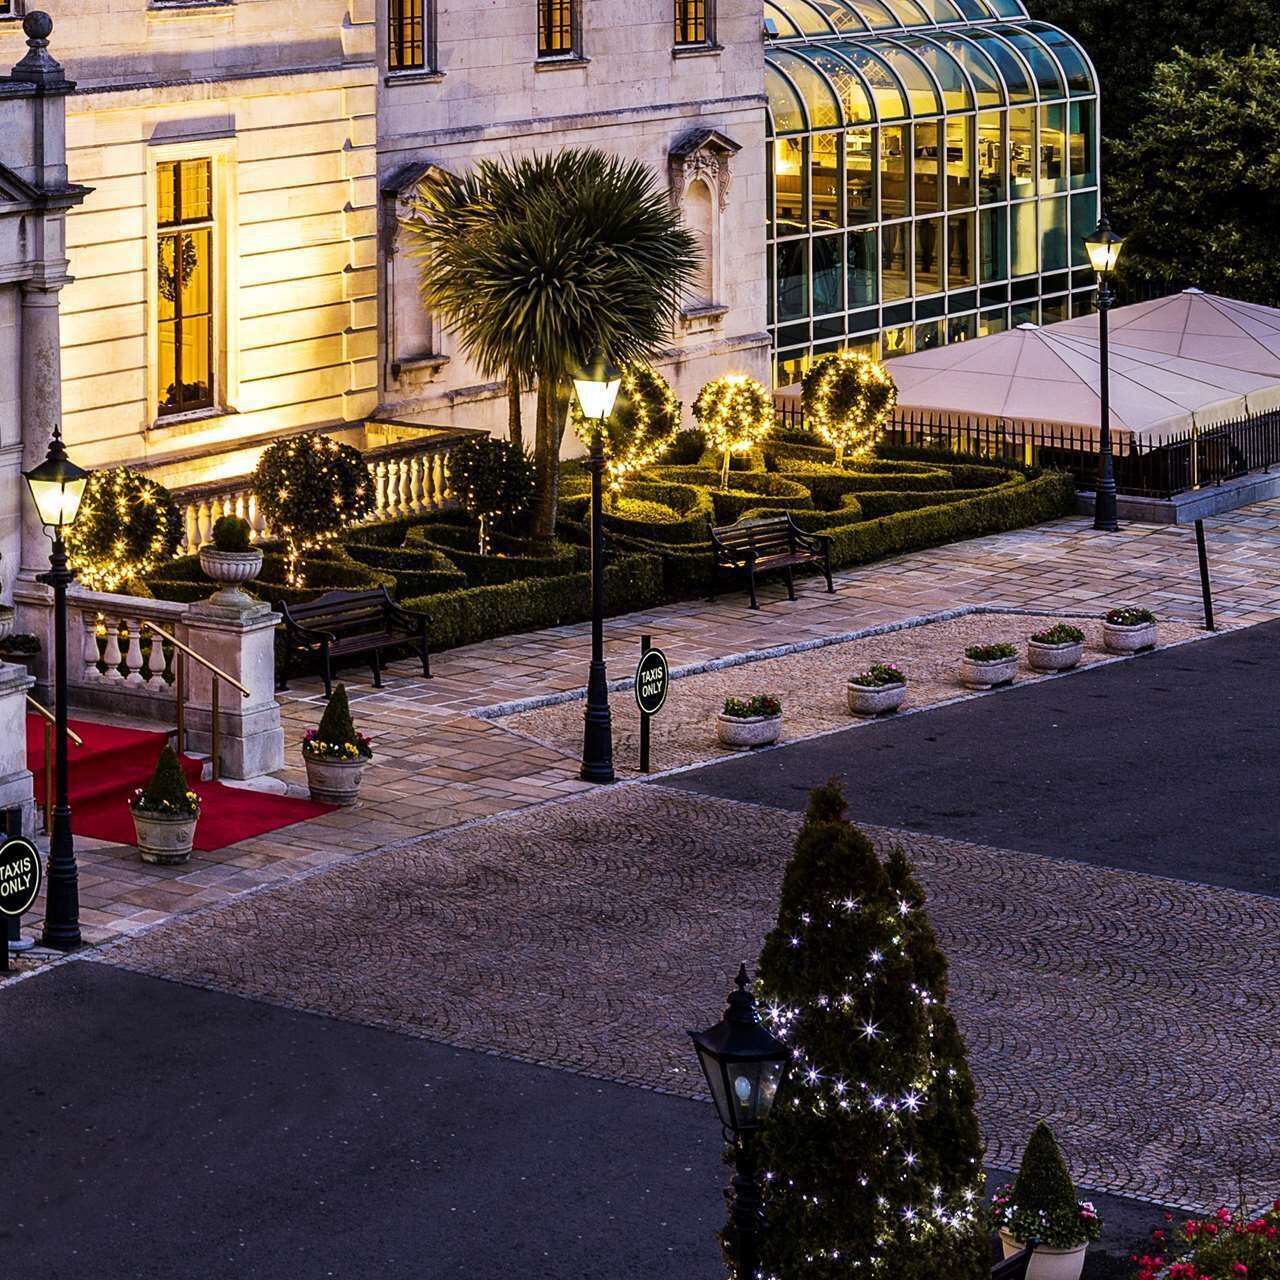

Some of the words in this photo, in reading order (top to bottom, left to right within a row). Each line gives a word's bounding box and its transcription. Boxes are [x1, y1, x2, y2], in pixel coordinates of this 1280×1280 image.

[641, 666, 662, 683] TAXIS
[642, 680, 662, 697] ONLY
[0, 873, 31, 896] ONLY
